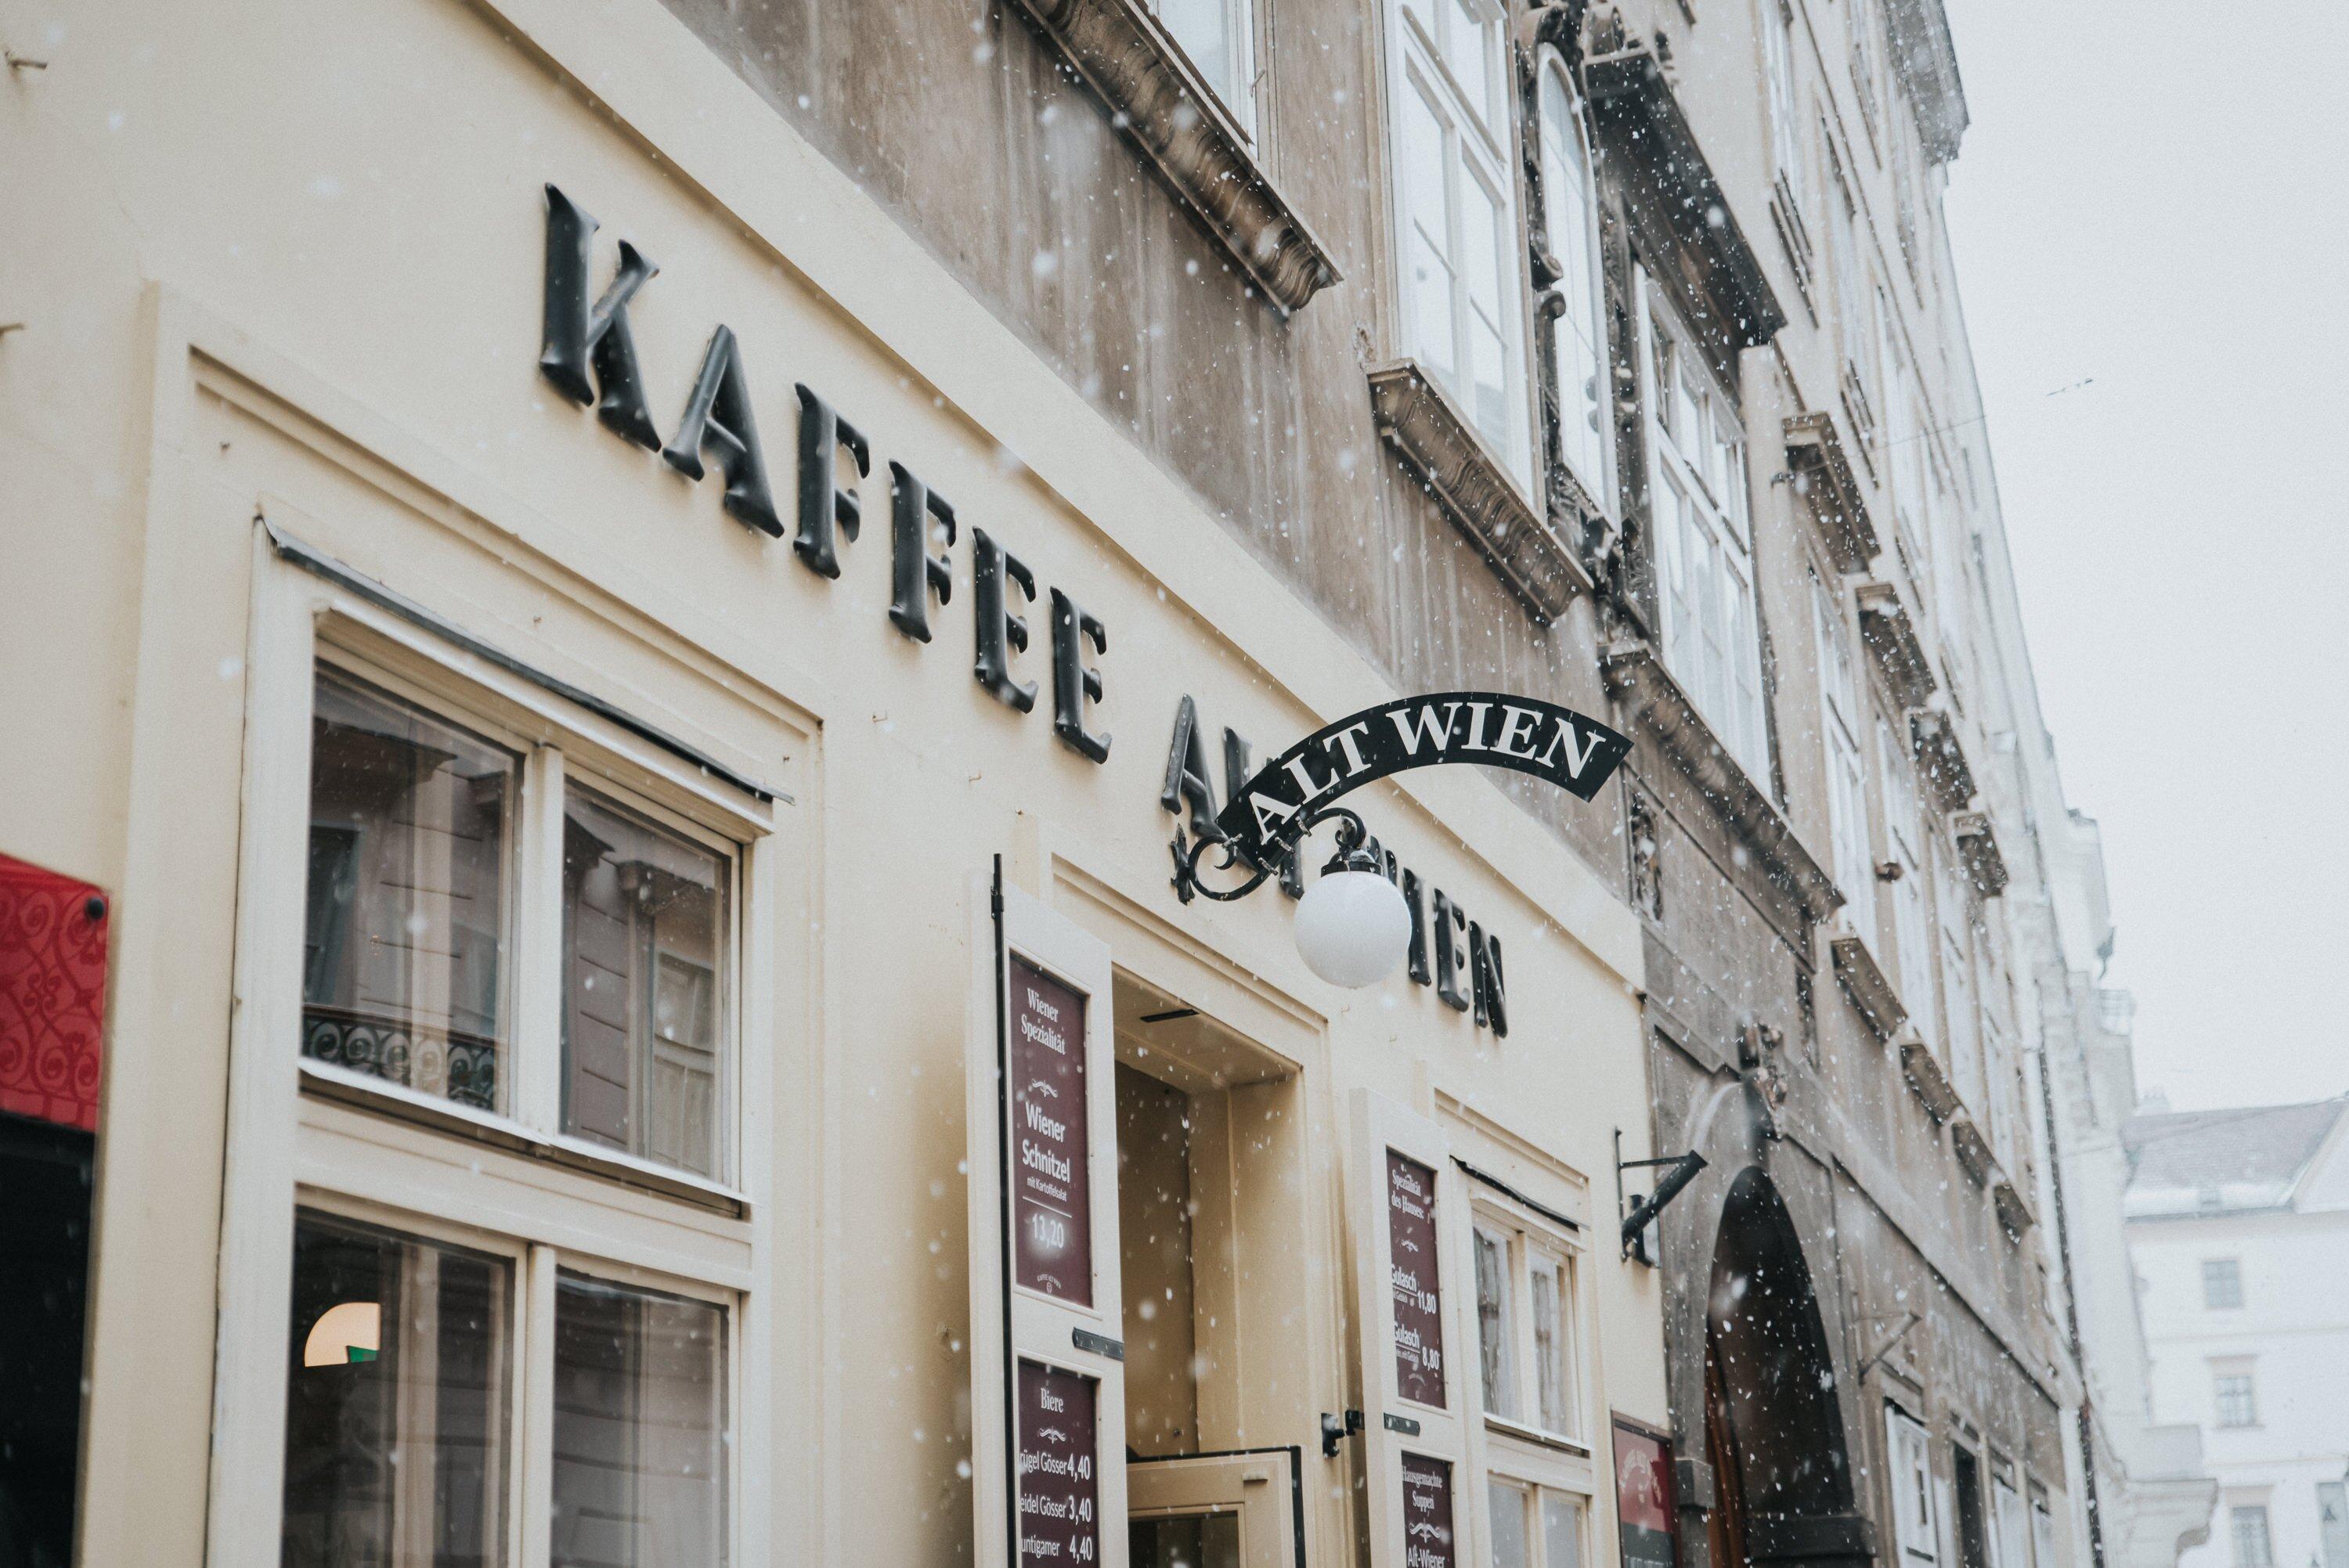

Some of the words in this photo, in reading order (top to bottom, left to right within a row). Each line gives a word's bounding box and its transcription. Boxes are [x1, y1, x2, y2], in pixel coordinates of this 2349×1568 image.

[539, 182, 1113, 765] KAFFEE
[1248, 720, 1372, 846] ALT
[1385, 702, 1607, 780] WIEN
[1027, 987, 1059, 1022] Wiener
[1021, 1013, 1066, 1055] Spezialität
[1025, 1100, 1066, 1143] Wiener
[1022, 1139, 1070, 1184] Schnitzel
[1417, 1289, 1436, 1315] 11,80
[1422, 1346, 1440, 1372] 8,80
[1041, 1387, 1064, 1414] Biere
[1019, 1449, 1040, 1473] rügel
[1040, 1452, 1067, 1476] Gösser
[1067, 1453, 1091, 1483] 4,40
[1019, 1494, 1038, 1514] eidel
[1039, 1496, 1066, 1519] Gösser
[1068, 1494, 1092, 1526] 3,40
[1020, 1534, 1060, 1559] untigamer
[1070, 1535, 1093, 1564] 4,40
